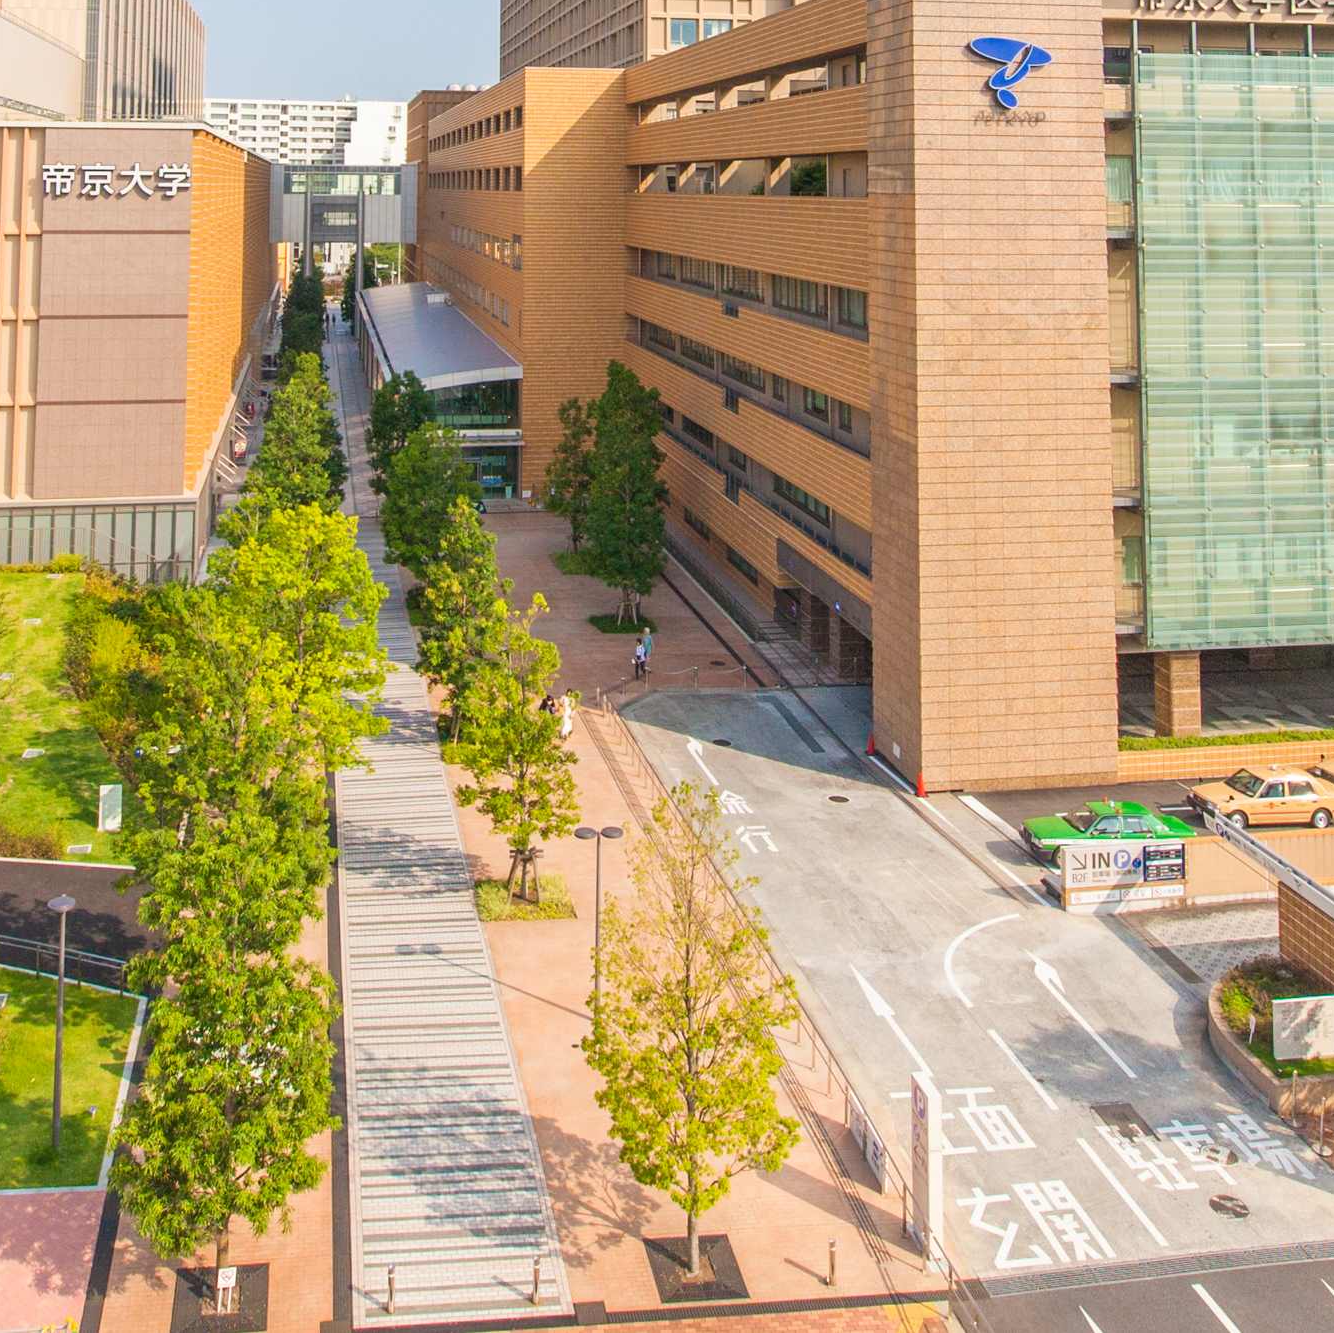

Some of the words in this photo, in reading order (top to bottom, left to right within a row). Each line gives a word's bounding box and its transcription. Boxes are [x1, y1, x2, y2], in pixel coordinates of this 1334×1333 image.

[42, 162, 191, 197] 帝京大学
[1092, 852, 1110, 869] IN
[956, 1180, 1117, 1269] 玄関
